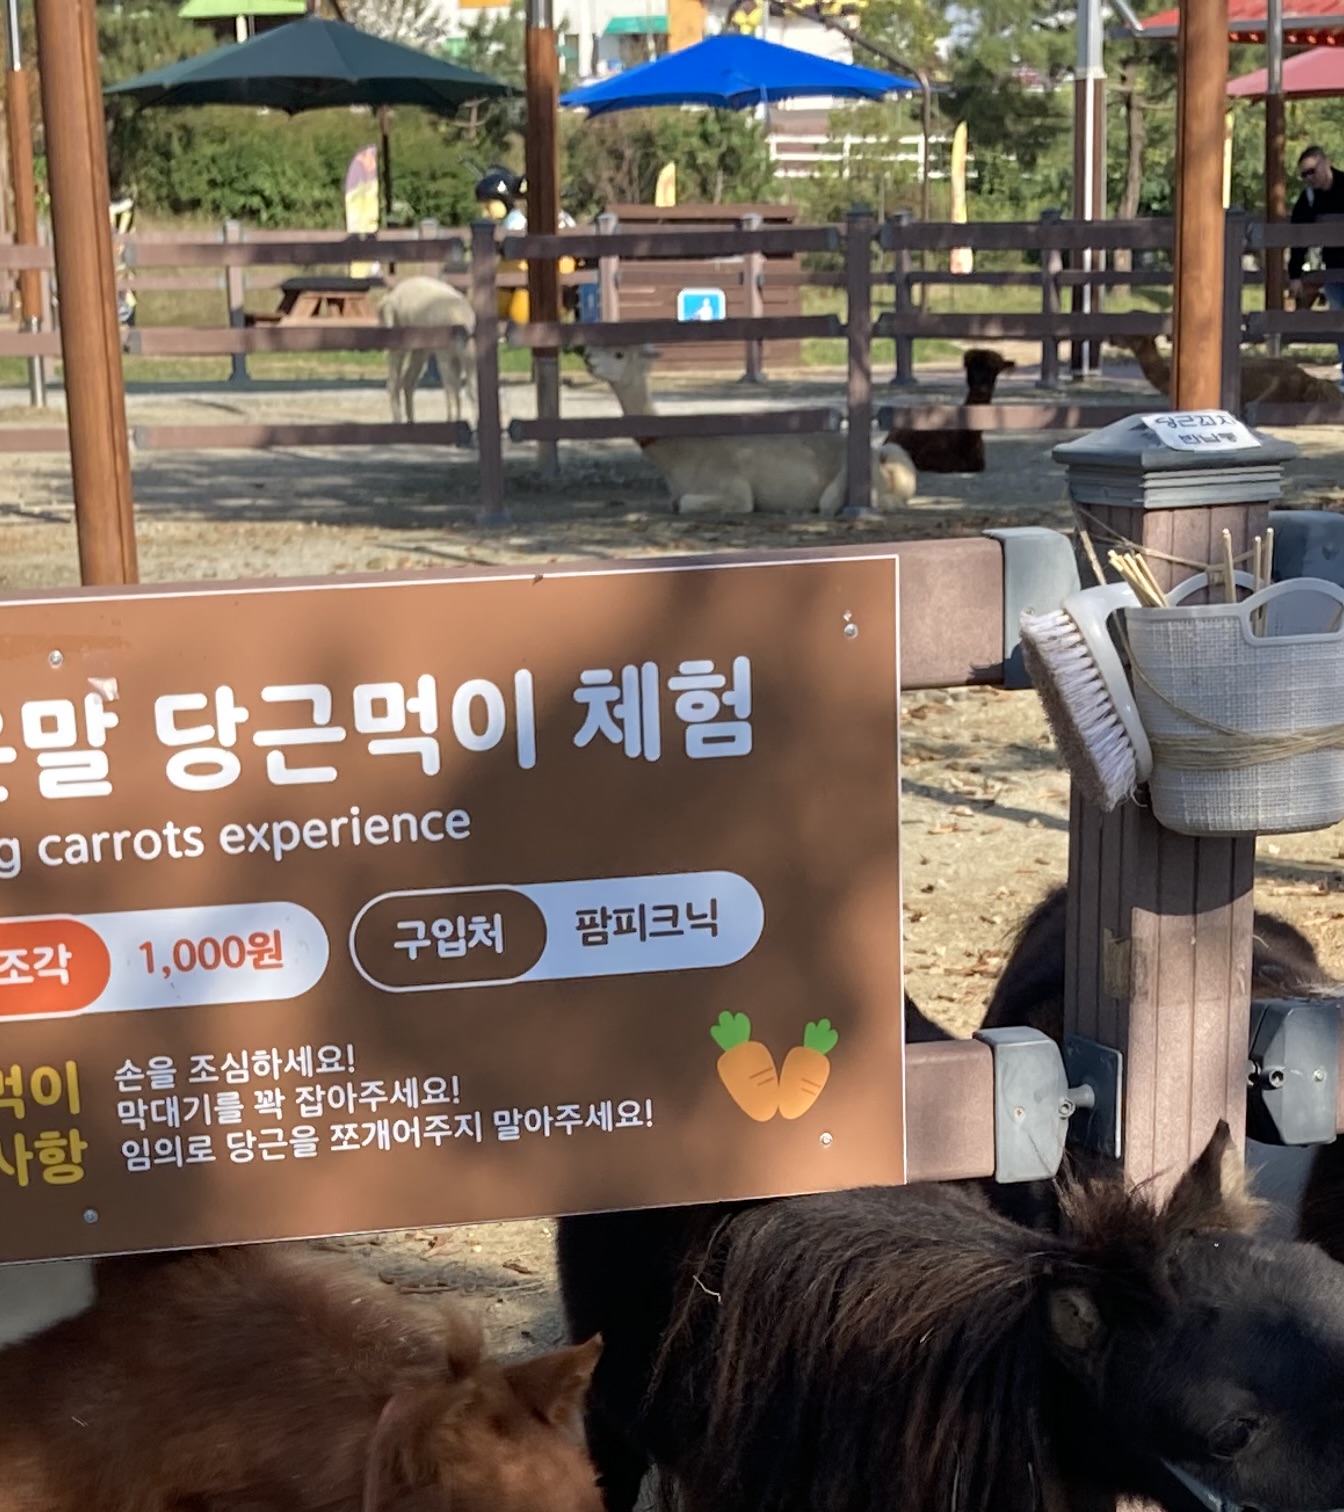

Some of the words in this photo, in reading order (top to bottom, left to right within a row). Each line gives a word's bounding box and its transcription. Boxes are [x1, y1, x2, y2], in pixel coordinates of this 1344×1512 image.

[154, 668, 537, 791] 당근먹이
[573, 655, 753, 763] 체험
[37, 821, 205, 867] carrots
[219, 806, 471, 861] experience
[393, 912, 505, 961] 구입처
[575, 898, 719, 948] 팜피크닉
[139, 928, 284, 981] 1,000원
[114, 1055, 177, 1093] 손을
[188, 1043, 356, 1085] 조심하세요!
[117, 1090, 245, 1132] 막대기를
[253, 1086, 287, 1121] 꽉
[295, 1075, 461, 1119] 잡아주세요!
[121, 1134, 217, 1173] 임의로
[225, 1124, 320, 1165] 당근을
[329, 1111, 483, 1153] 쪼개어주지
[492, 1098, 654, 1143] 말아주세요!
